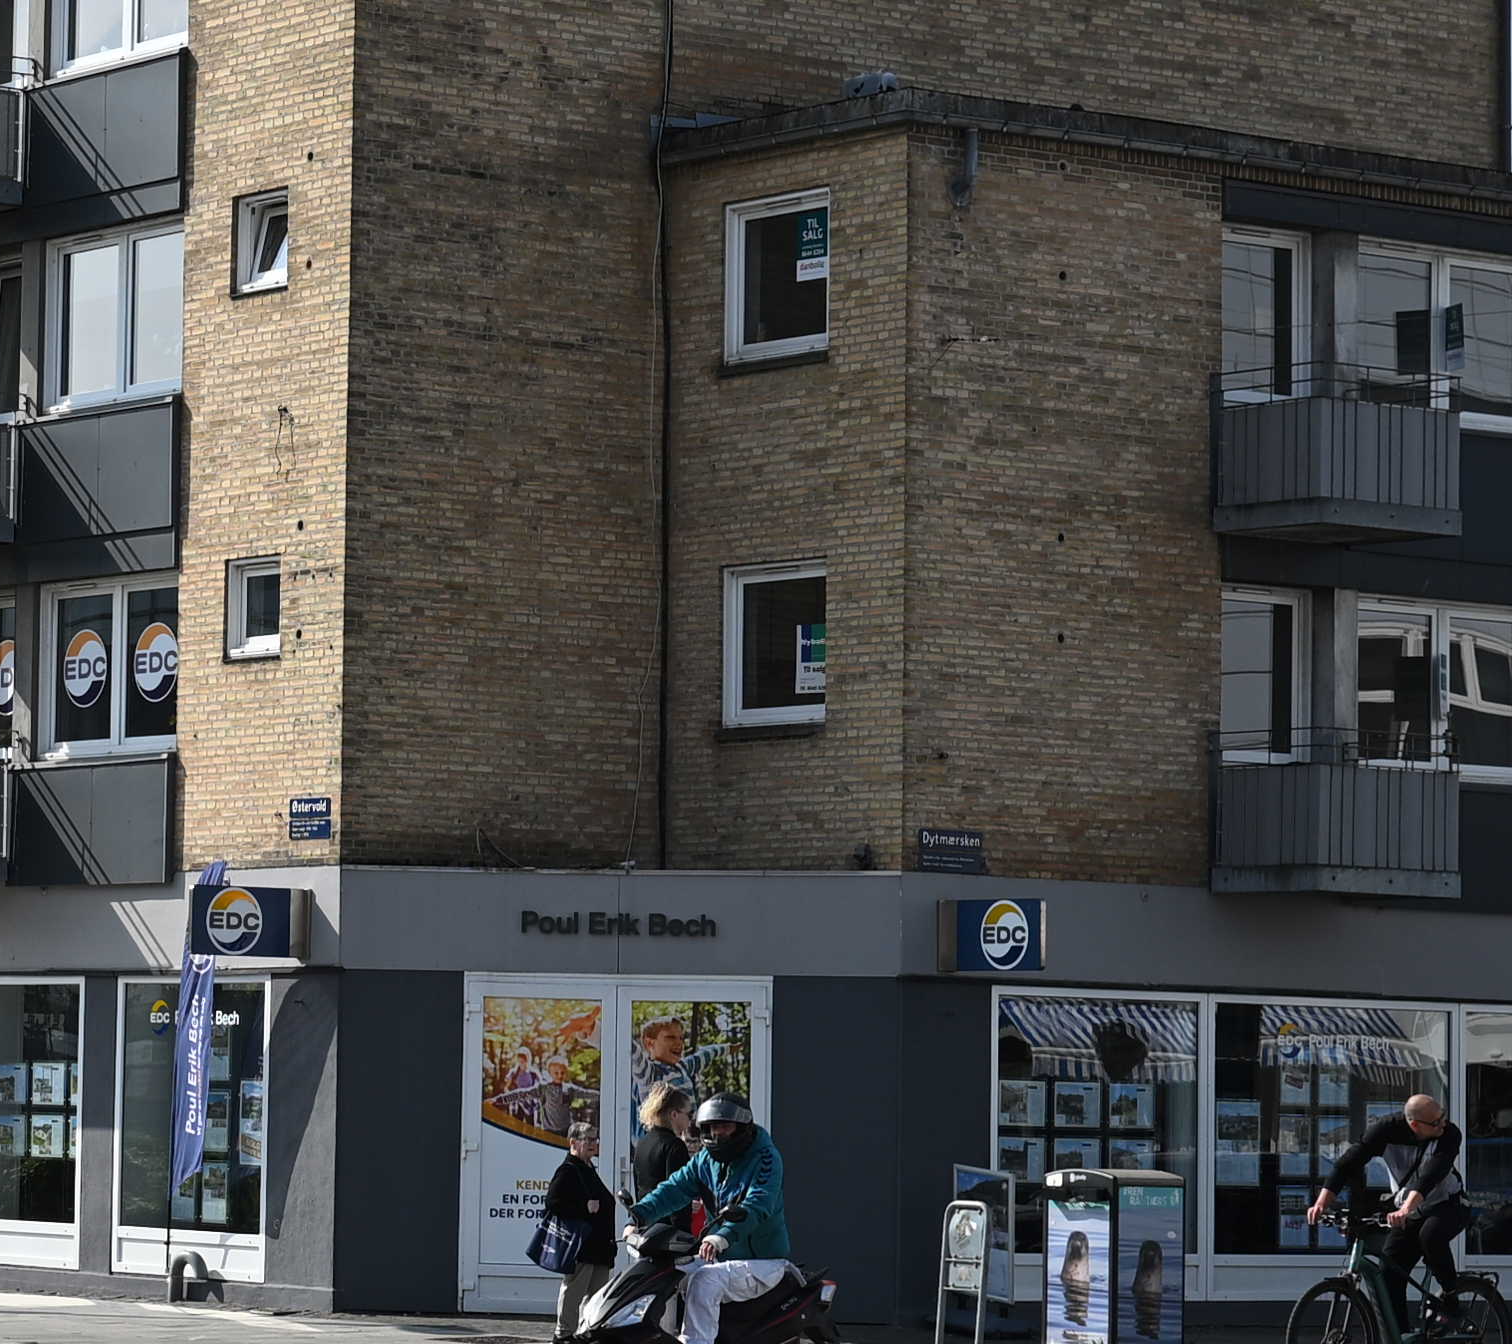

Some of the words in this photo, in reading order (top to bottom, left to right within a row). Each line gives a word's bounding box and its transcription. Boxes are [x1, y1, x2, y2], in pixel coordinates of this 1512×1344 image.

[807, 217, 819, 229] TIL
[802, 228, 824, 241] SALG
[64, 657, 107, 680] EDC
[135, 650, 177, 674] EDC
[292, 799, 327, 813] Østervold
[922, 831, 981, 848] Dytmærsken
[208, 911, 260, 931] EDC
[521, 910, 579, 935] Poul
[588, 911, 641, 936] Erik
[648, 913, 717, 937] Bech
[983, 926, 1026, 944] EDC
[150, 1012, 170, 1023] EDC
[215, 1010, 240, 1025] Bech
[188, 994, 200, 1044] Bech
[1309, 1034, 1334, 1048] Poul
[1361, 1036, 1391, 1050] Bech
[187, 1048, 197, 1087] Erik
[185, 1090, 197, 1135] Poul
[516, 1180, 551, 1191] KEND
[502, 1194, 519, 1204] EN
[489, 1208, 514, 1218] DER
[518, 1209, 545, 1219] FOR
